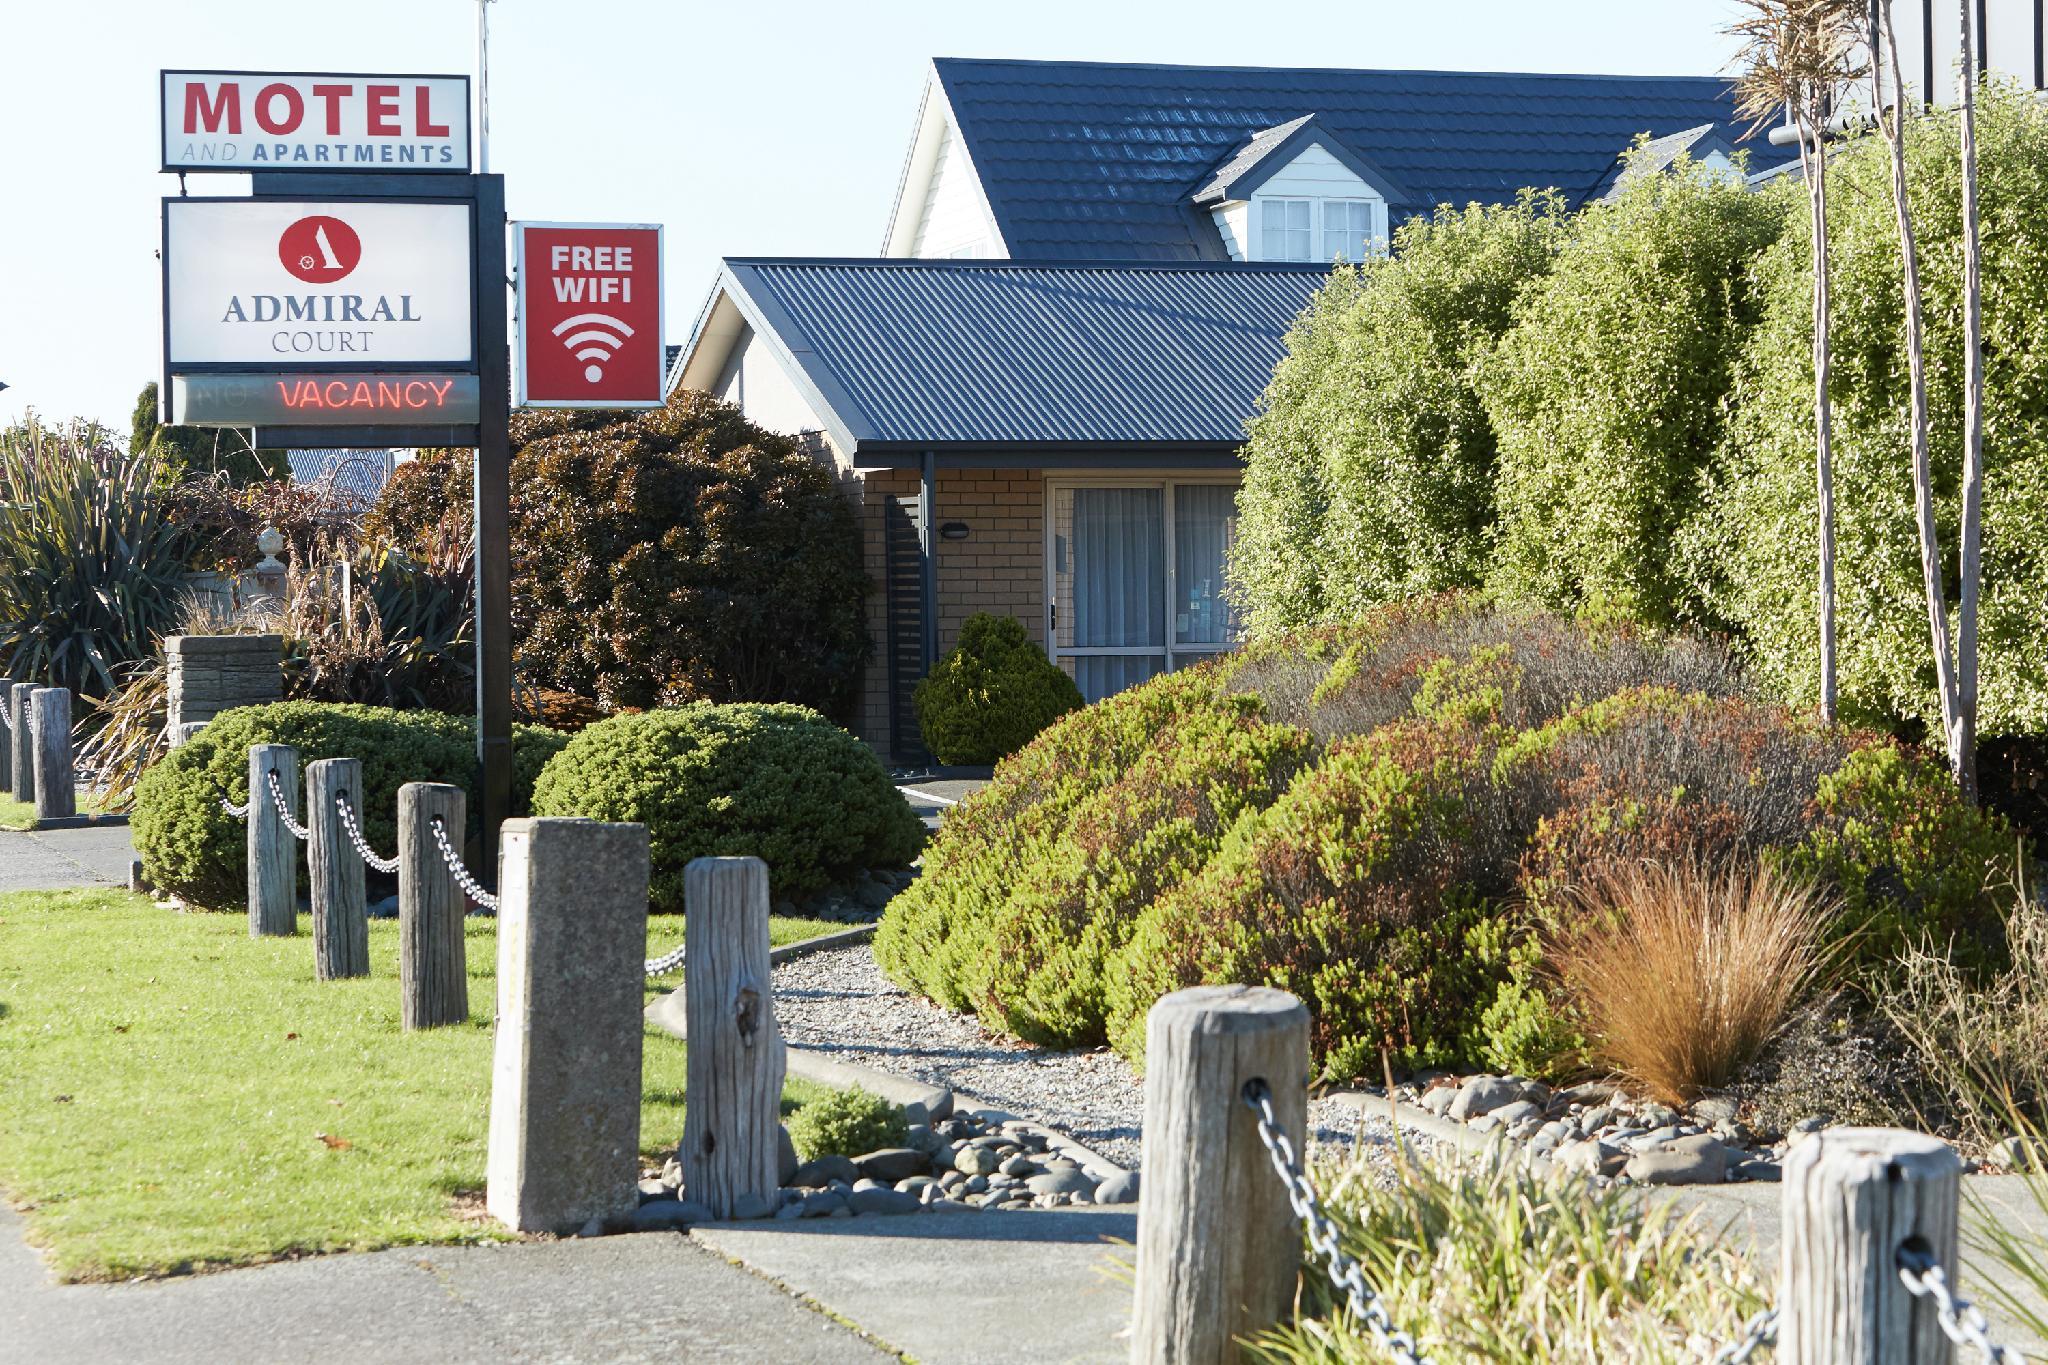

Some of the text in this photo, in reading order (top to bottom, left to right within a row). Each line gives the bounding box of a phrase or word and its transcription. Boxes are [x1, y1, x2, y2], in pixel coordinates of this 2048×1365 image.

[183, 82, 450, 137] MOTEL
[181, 143, 453, 163] AND APARTMENTS
[552, 246, 633, 271] FREE
[552, 277, 631, 303] WIFI
[221, 295, 422, 323] ADMIRAL
[272, 331, 374, 353] COURT
[277, 381, 453, 408] VACANCY
